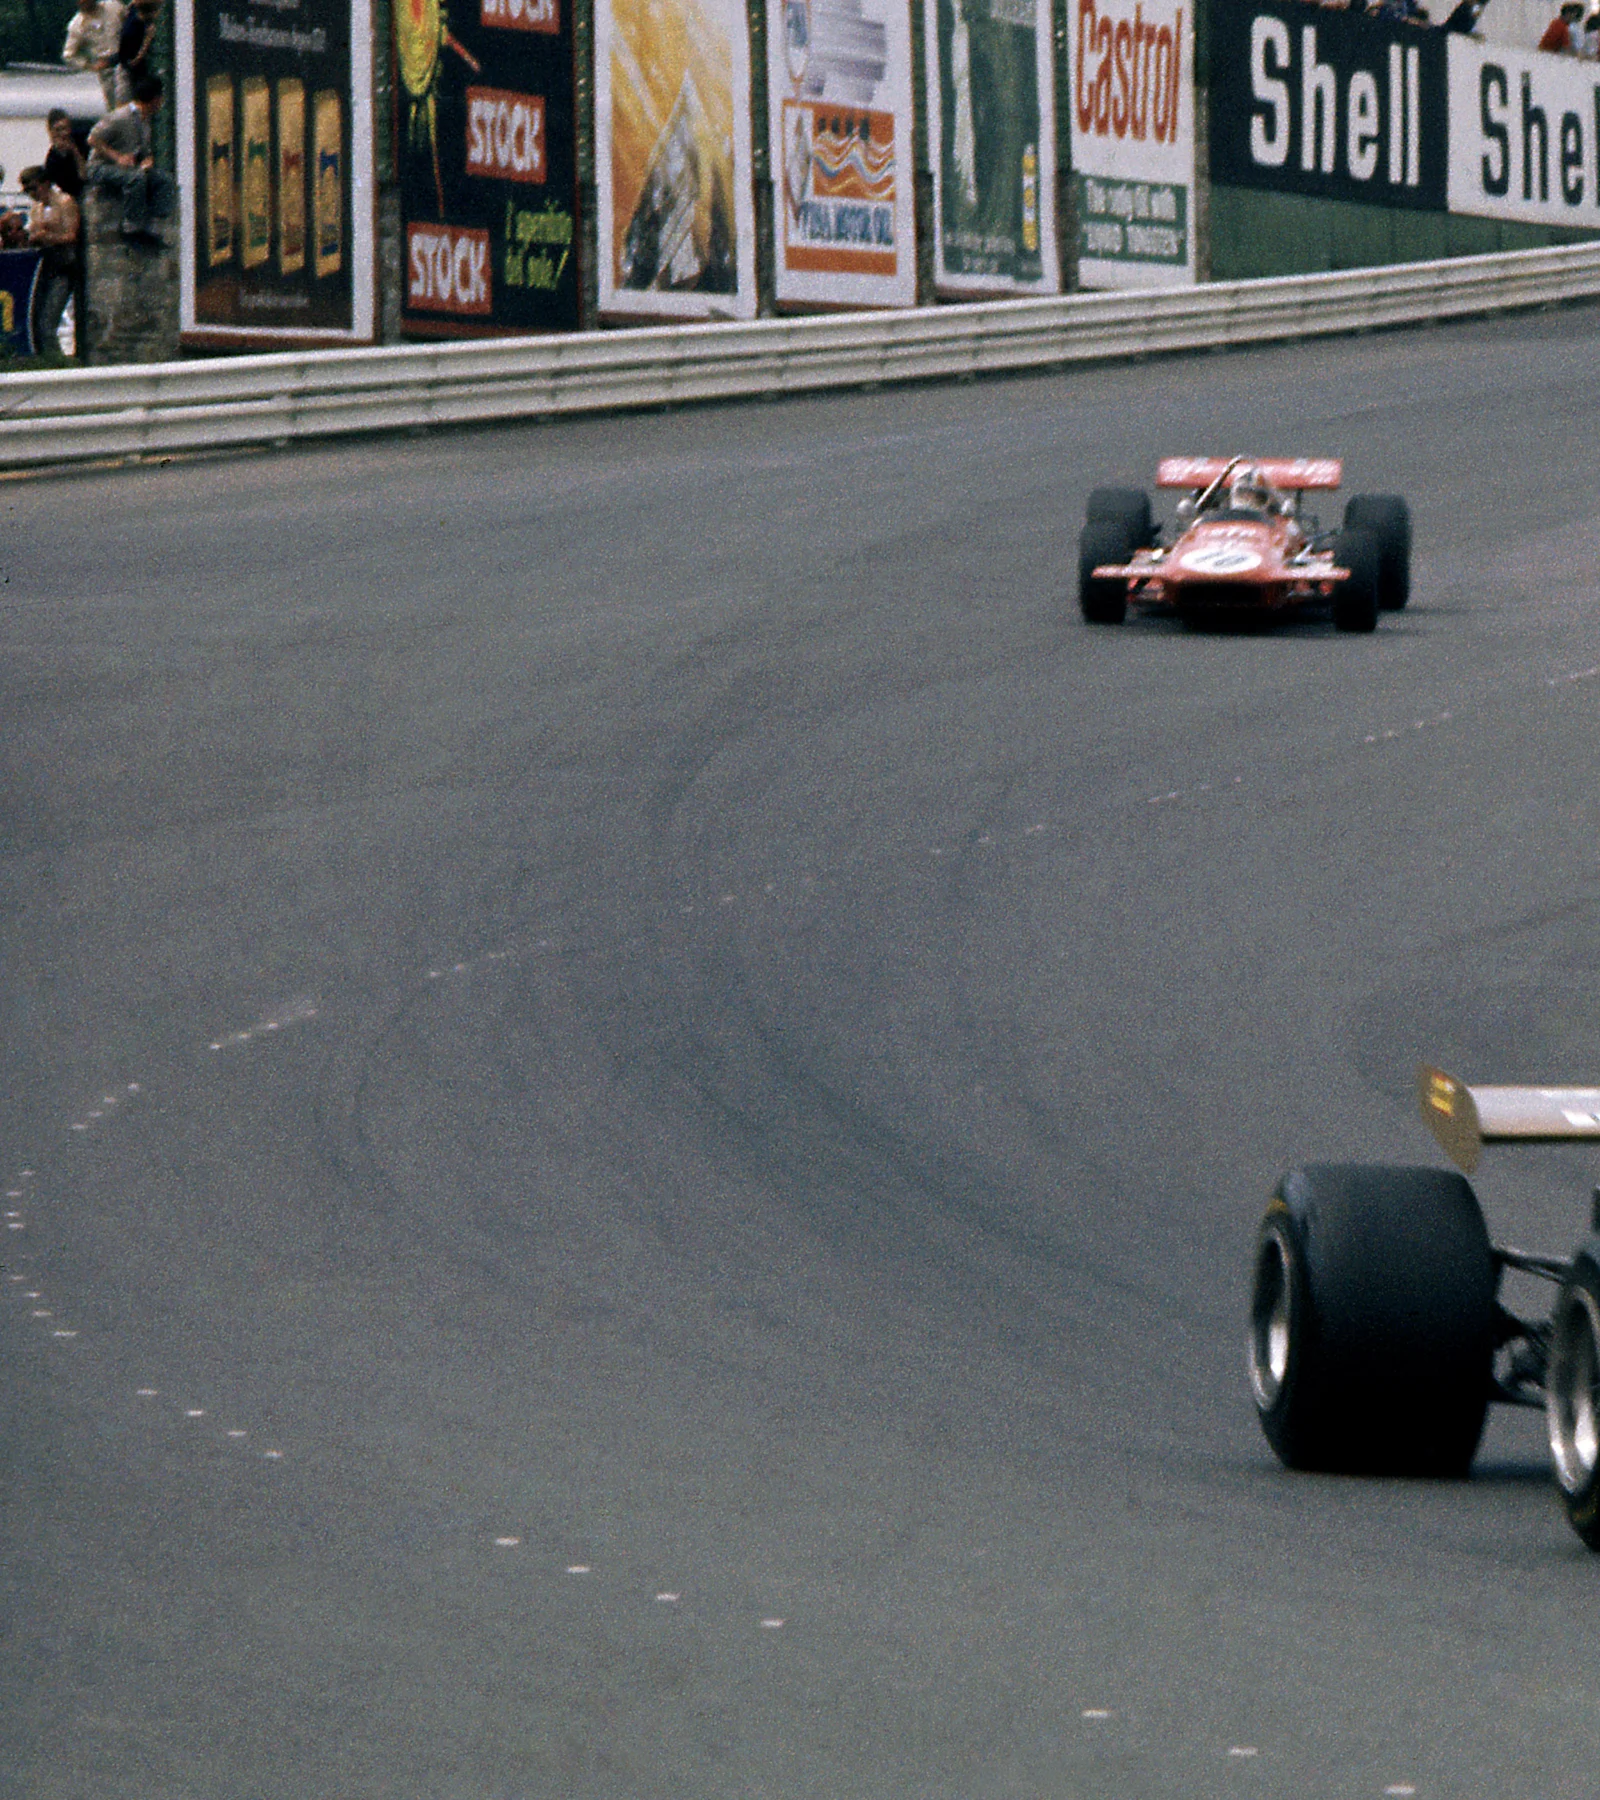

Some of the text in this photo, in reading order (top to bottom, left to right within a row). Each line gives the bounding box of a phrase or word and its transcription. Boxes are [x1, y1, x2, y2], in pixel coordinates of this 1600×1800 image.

[1076, 0, 1183, 144] Castrol
[1249, 16, 1421, 188] Shell
[469, 98, 541, 173] STOCK
[410, 233, 487, 304] STOCK
